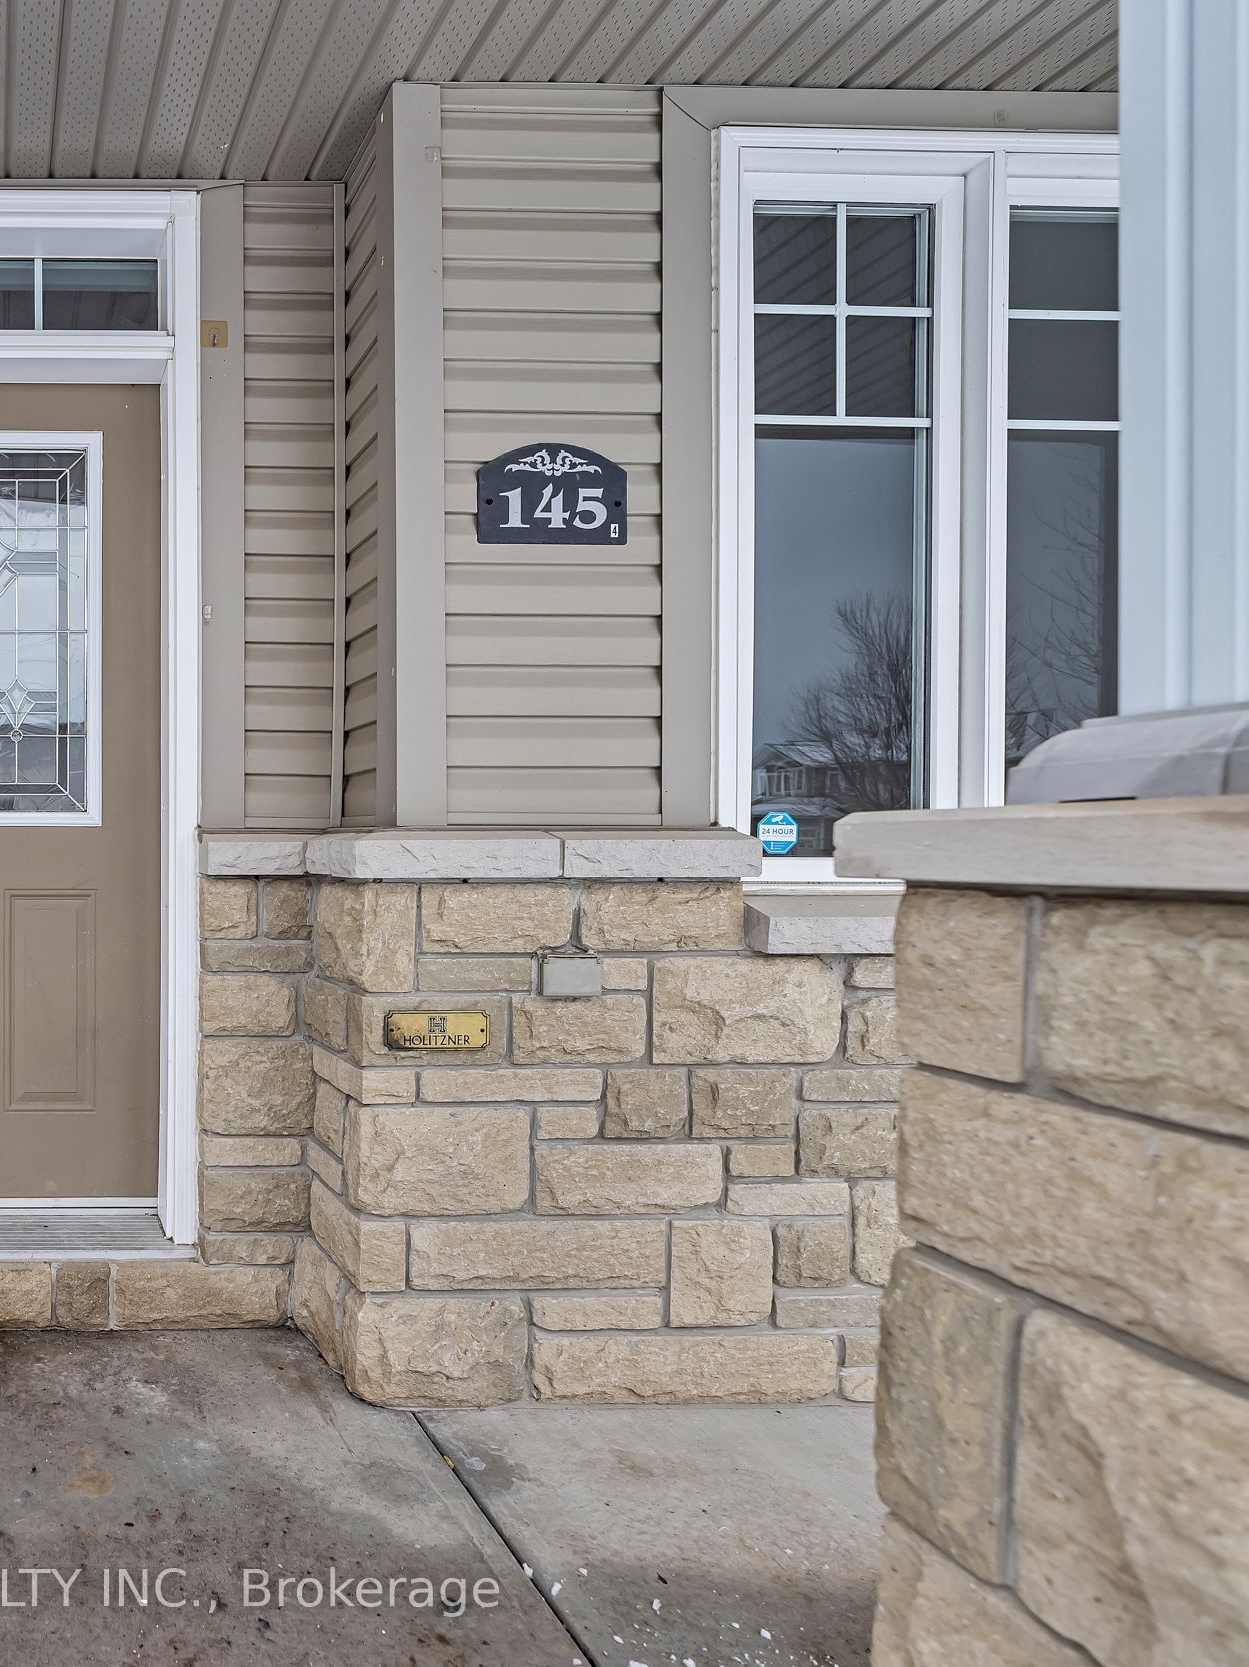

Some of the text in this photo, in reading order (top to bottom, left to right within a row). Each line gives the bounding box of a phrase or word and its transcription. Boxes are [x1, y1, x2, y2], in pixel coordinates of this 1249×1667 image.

[499, 483, 608, 530] 145
[612, 525, 618, 536] 4
[428, 1016, 447, 1034] H
[403, 1034, 471, 1046] HOLITZNER
